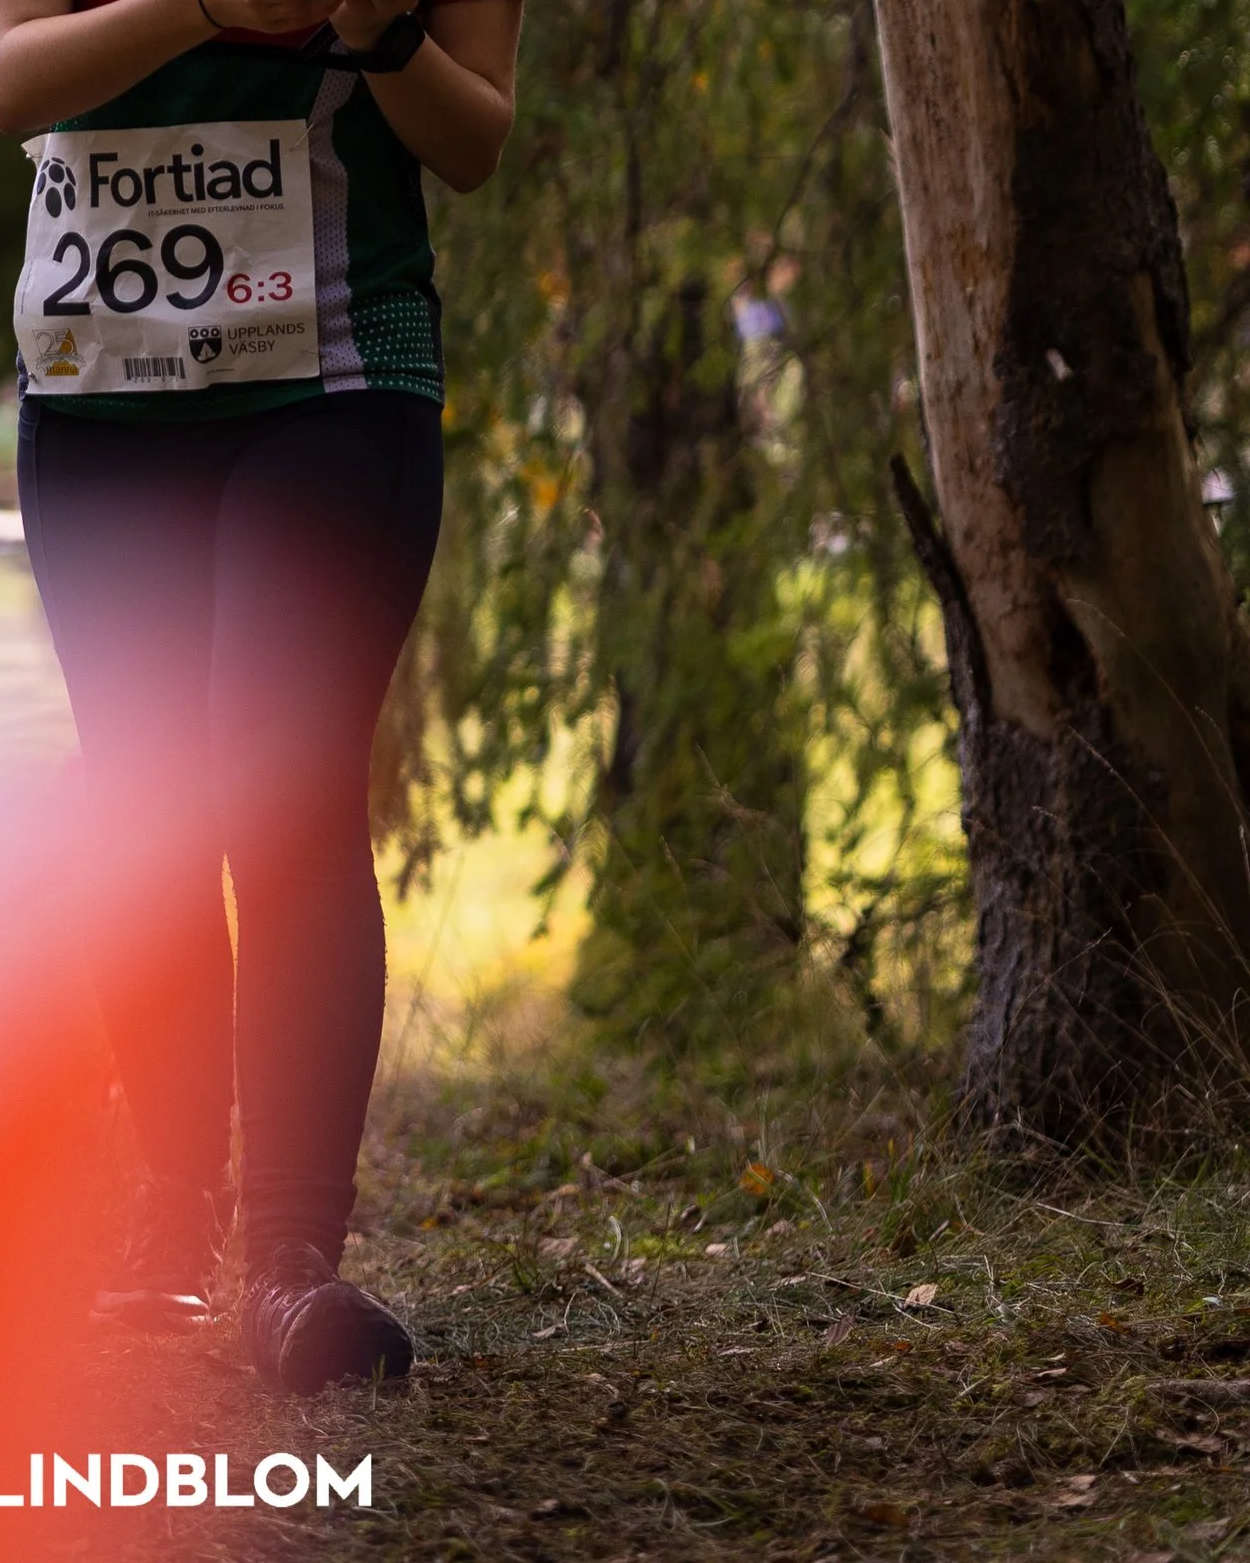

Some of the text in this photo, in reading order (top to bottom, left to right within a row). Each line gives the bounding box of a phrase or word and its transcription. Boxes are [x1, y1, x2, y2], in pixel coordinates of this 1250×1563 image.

[89, 138, 283, 208] Fortiad
[190, 206, 207, 215] MED
[207, 204, 255, 213] EFTERLEVNAD
[260, 202, 285, 211] FOKUS
[43, 223, 225, 317] 269
[226, 271, 294, 304] 6:3
[36, 330, 74, 356] 25
[227, 322, 306, 340] UPPLANDS
[228, 339, 276, 355] VÄSBY
